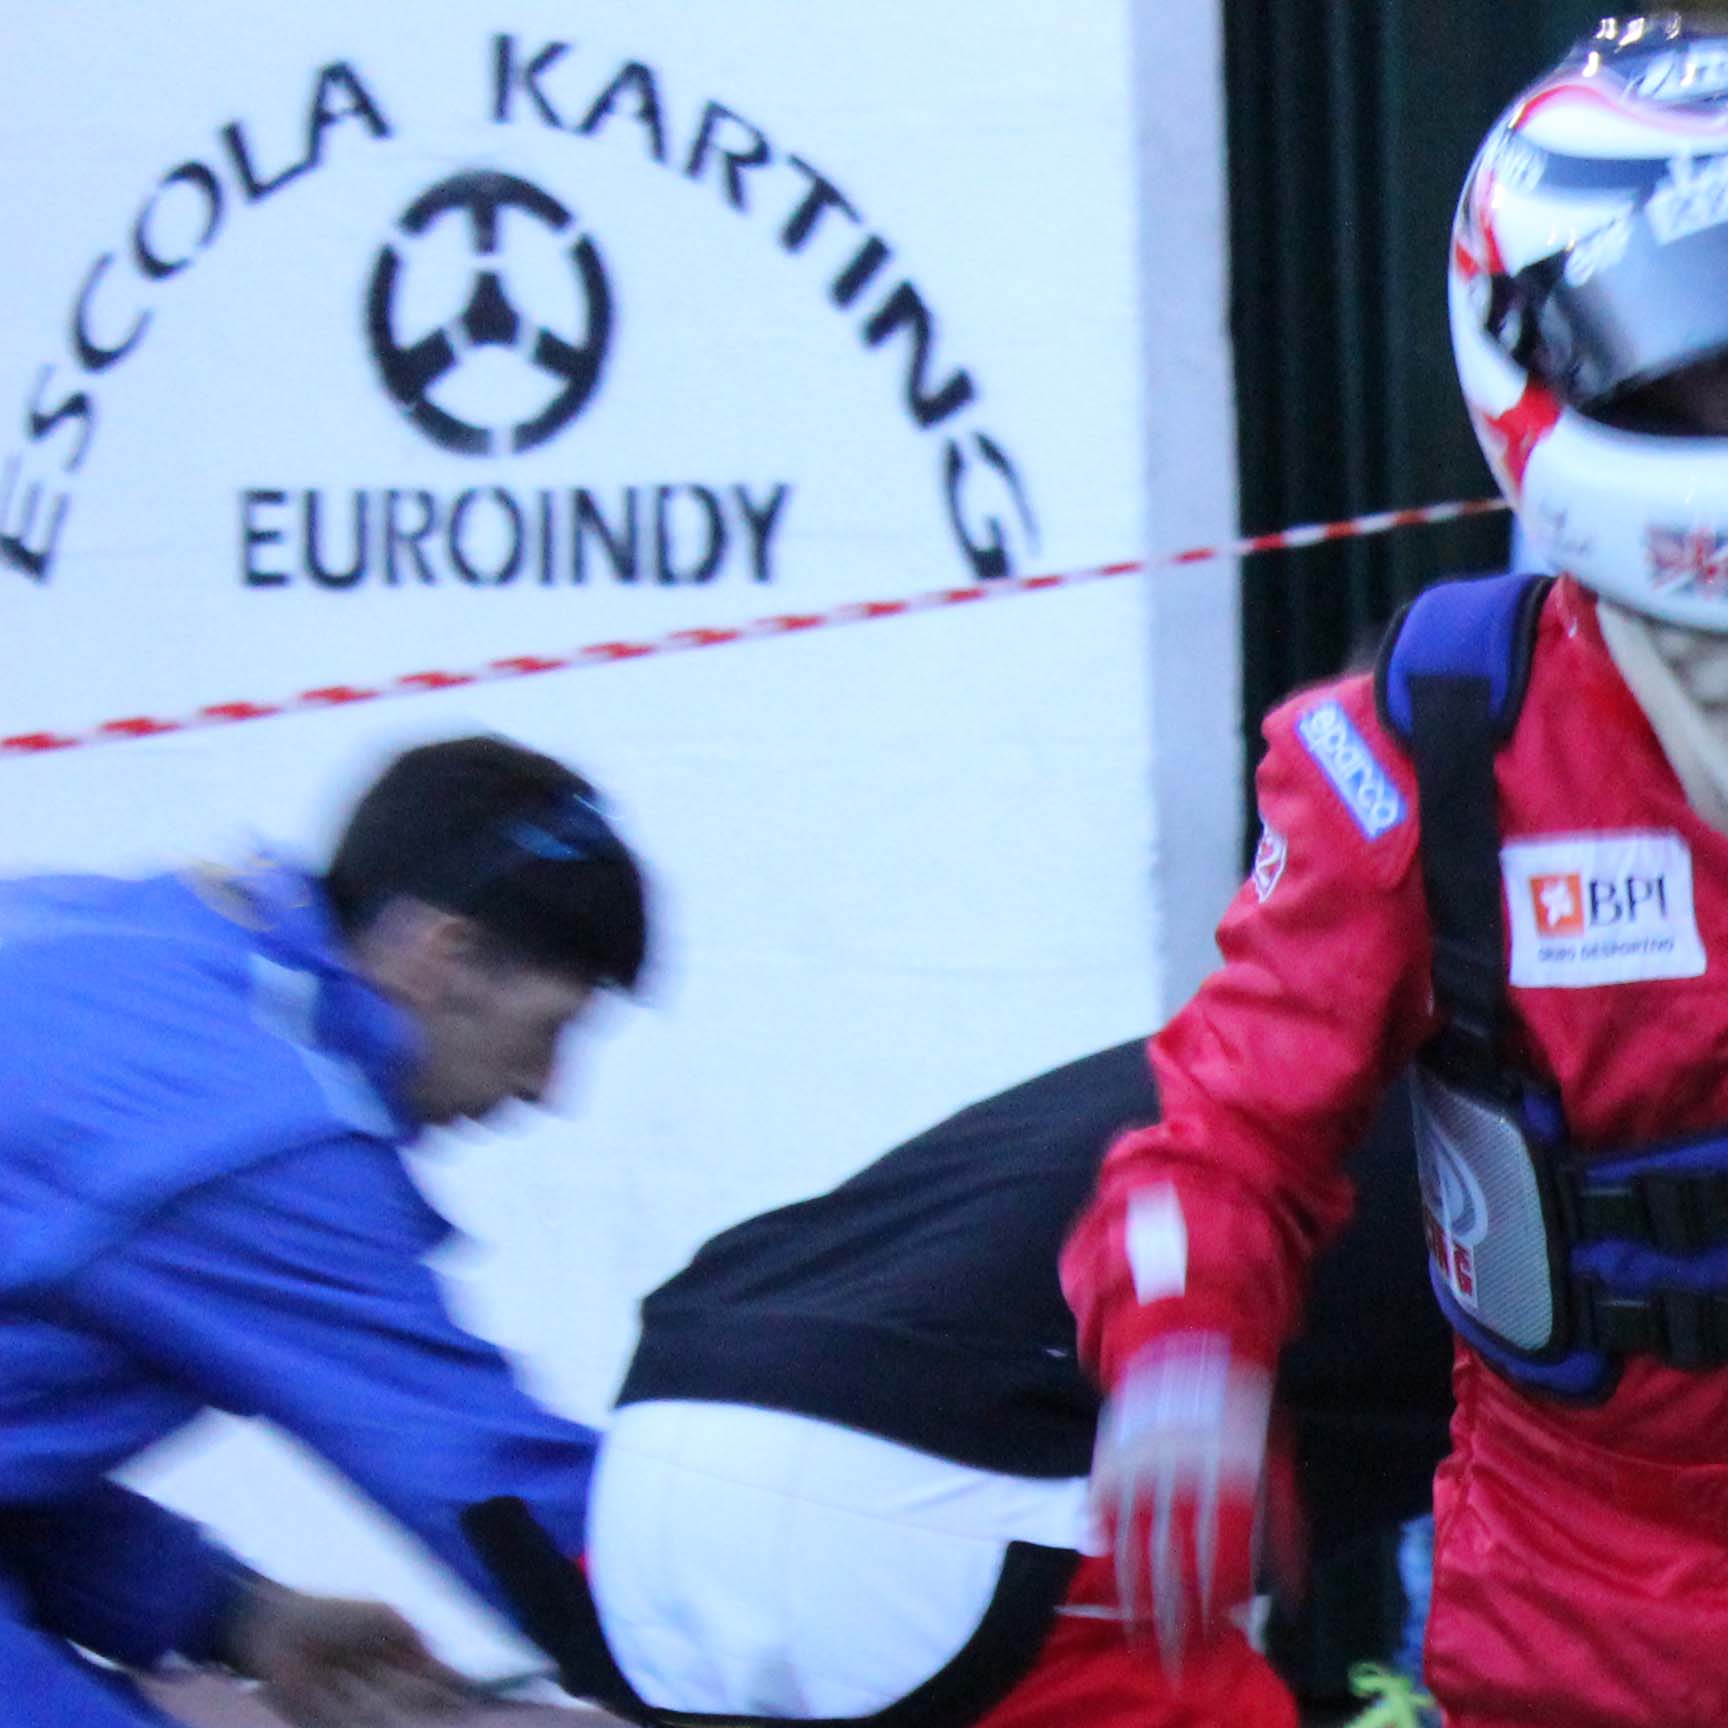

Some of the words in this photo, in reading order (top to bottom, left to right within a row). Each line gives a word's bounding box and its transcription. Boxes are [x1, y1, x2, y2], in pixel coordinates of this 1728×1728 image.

[0, 62, 394, 588] ESCOLA
[492, 33, 1043, 580] KARTING
[242, 485, 790, 589] EUROINDY
[1588, 872, 1668, 926] BPI
